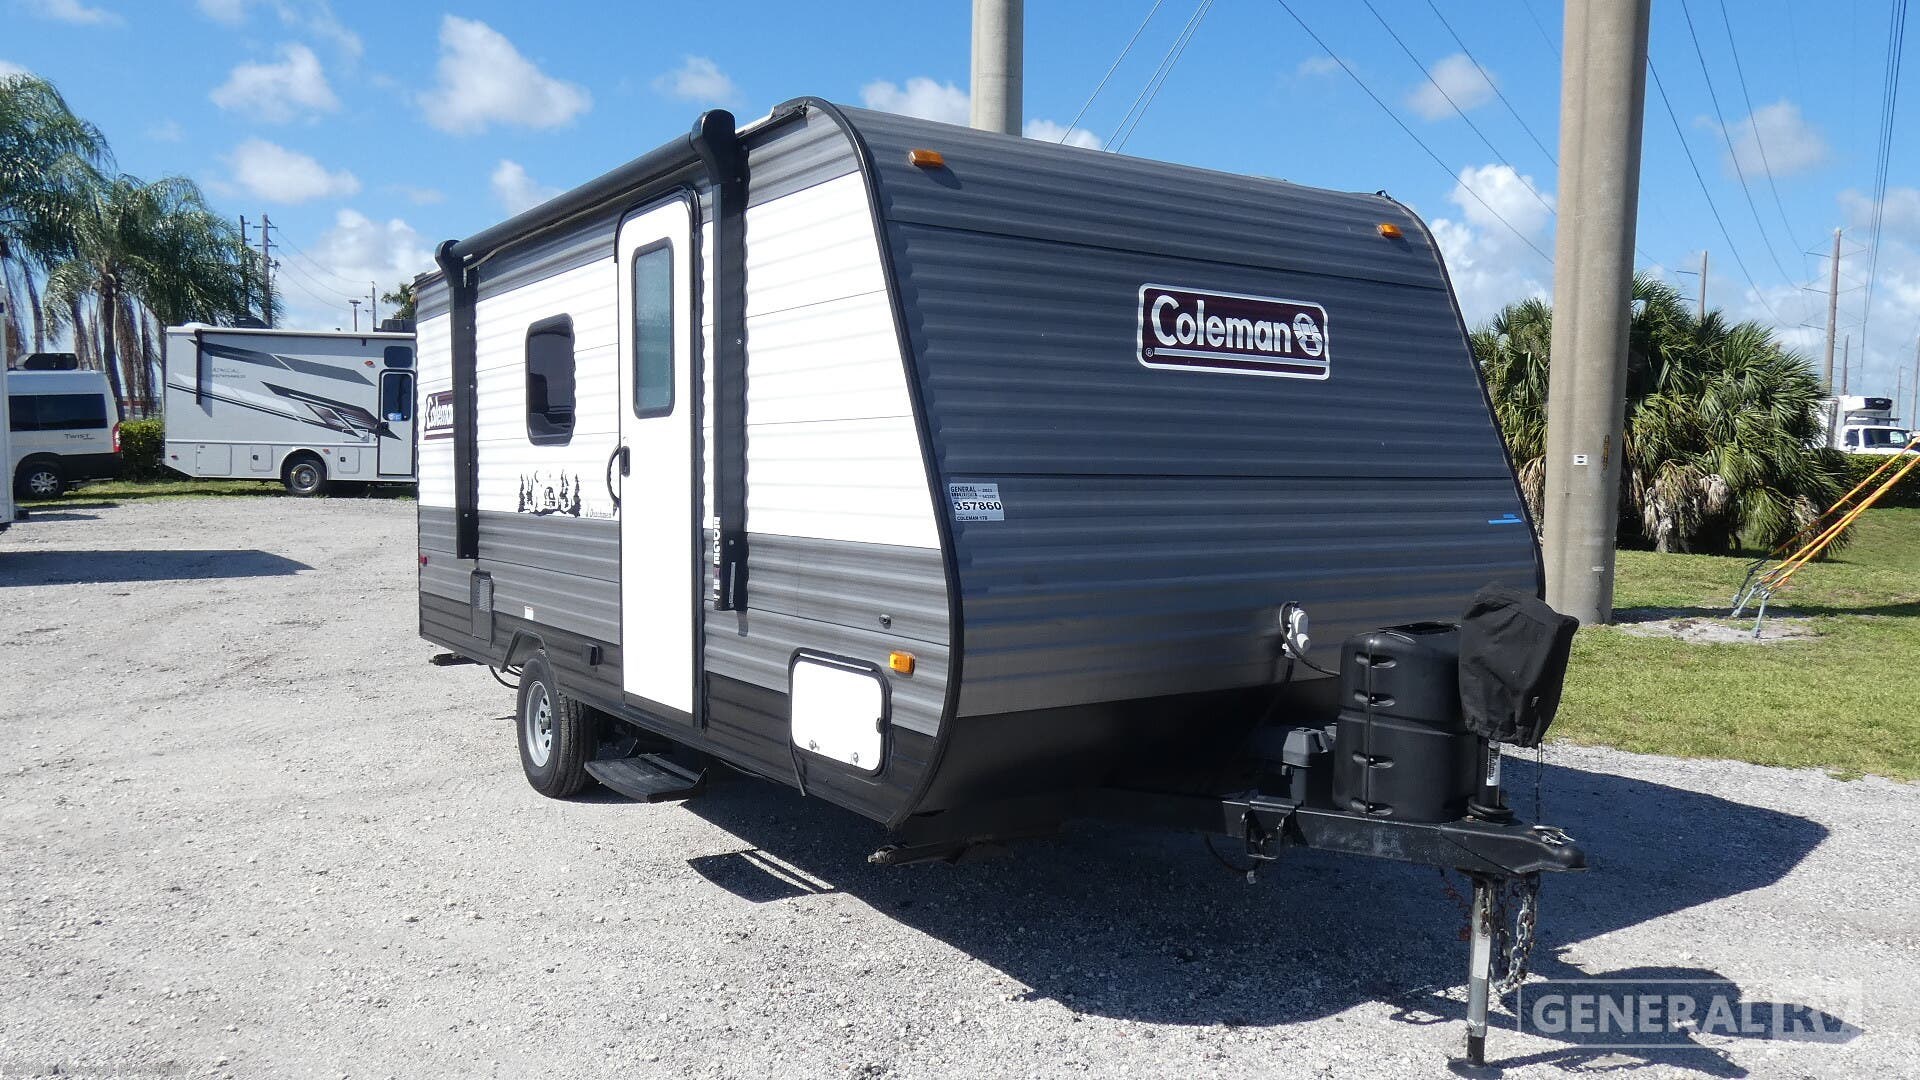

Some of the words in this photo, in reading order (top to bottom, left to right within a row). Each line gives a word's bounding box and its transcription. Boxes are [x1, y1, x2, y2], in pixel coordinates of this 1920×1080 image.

[1151, 294, 1292, 353] Coleman
[426, 396, 454, 429] Colema
[953, 501, 1002, 511] 357860
